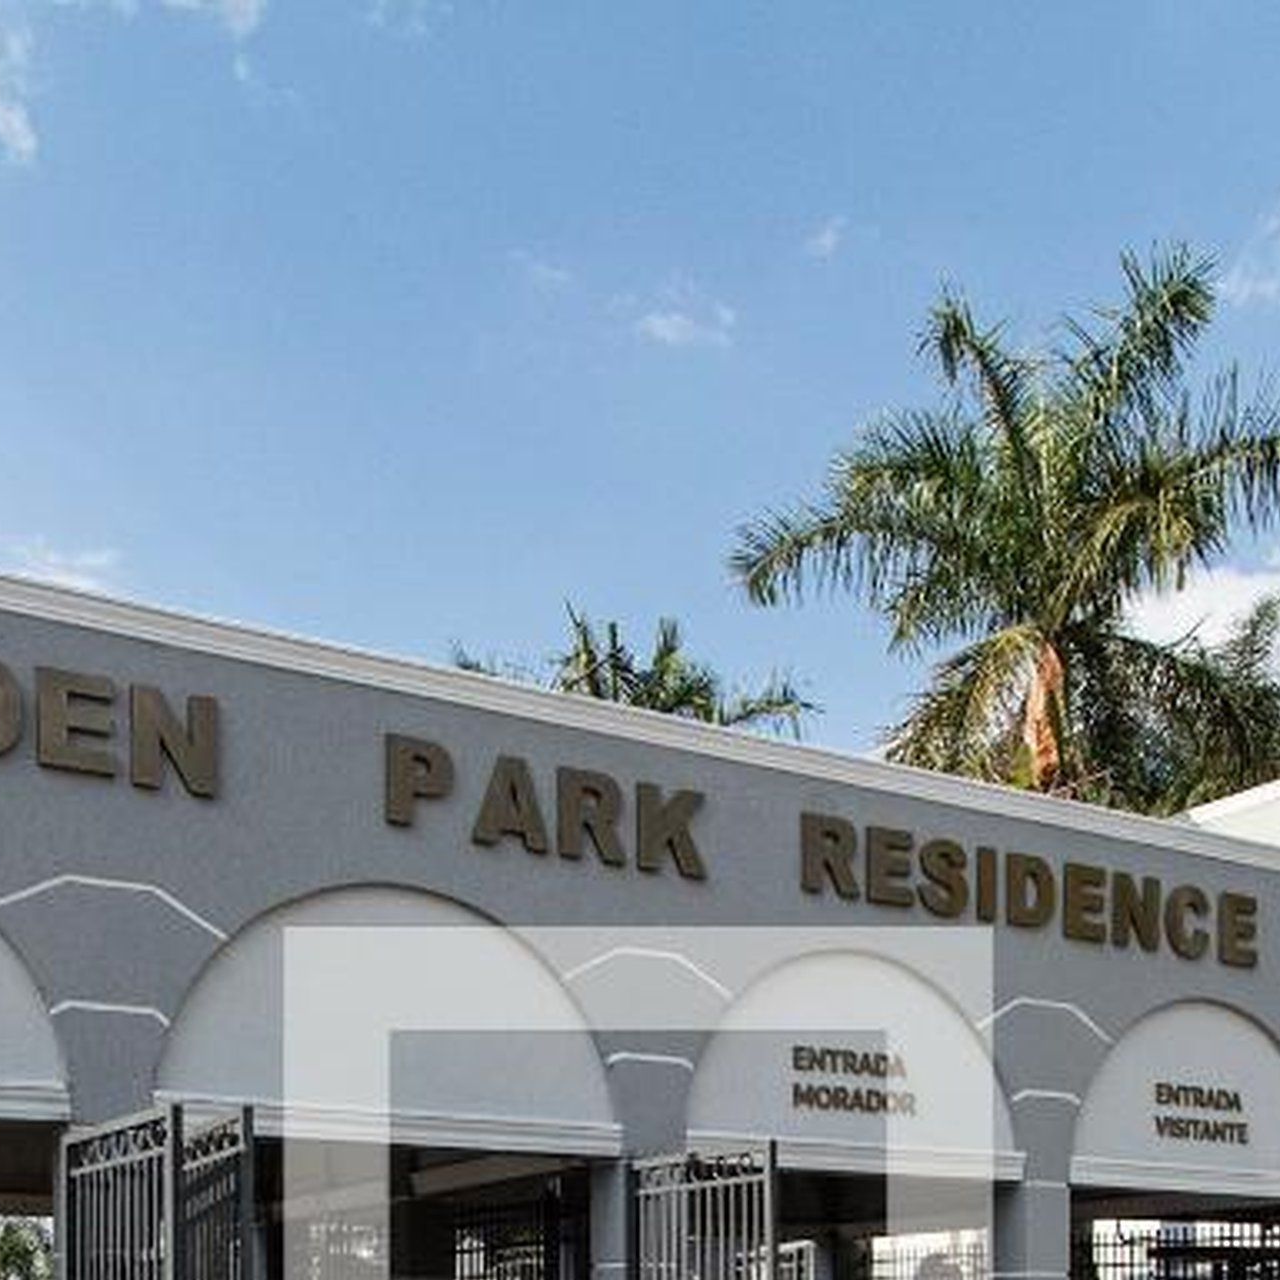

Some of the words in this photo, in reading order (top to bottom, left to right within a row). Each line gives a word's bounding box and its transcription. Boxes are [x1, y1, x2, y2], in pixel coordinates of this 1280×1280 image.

[384, 733, 708, 881] PARK
[798, 811, 1260, 969] RESIDENCE
[792, 1046, 907, 1077] ENTRADA
[792, 1082, 916, 1115] MORADOR
[1155, 1082, 1242, 1112] ENTRADA
[1154, 1115, 1248, 1145] VISITANTE
